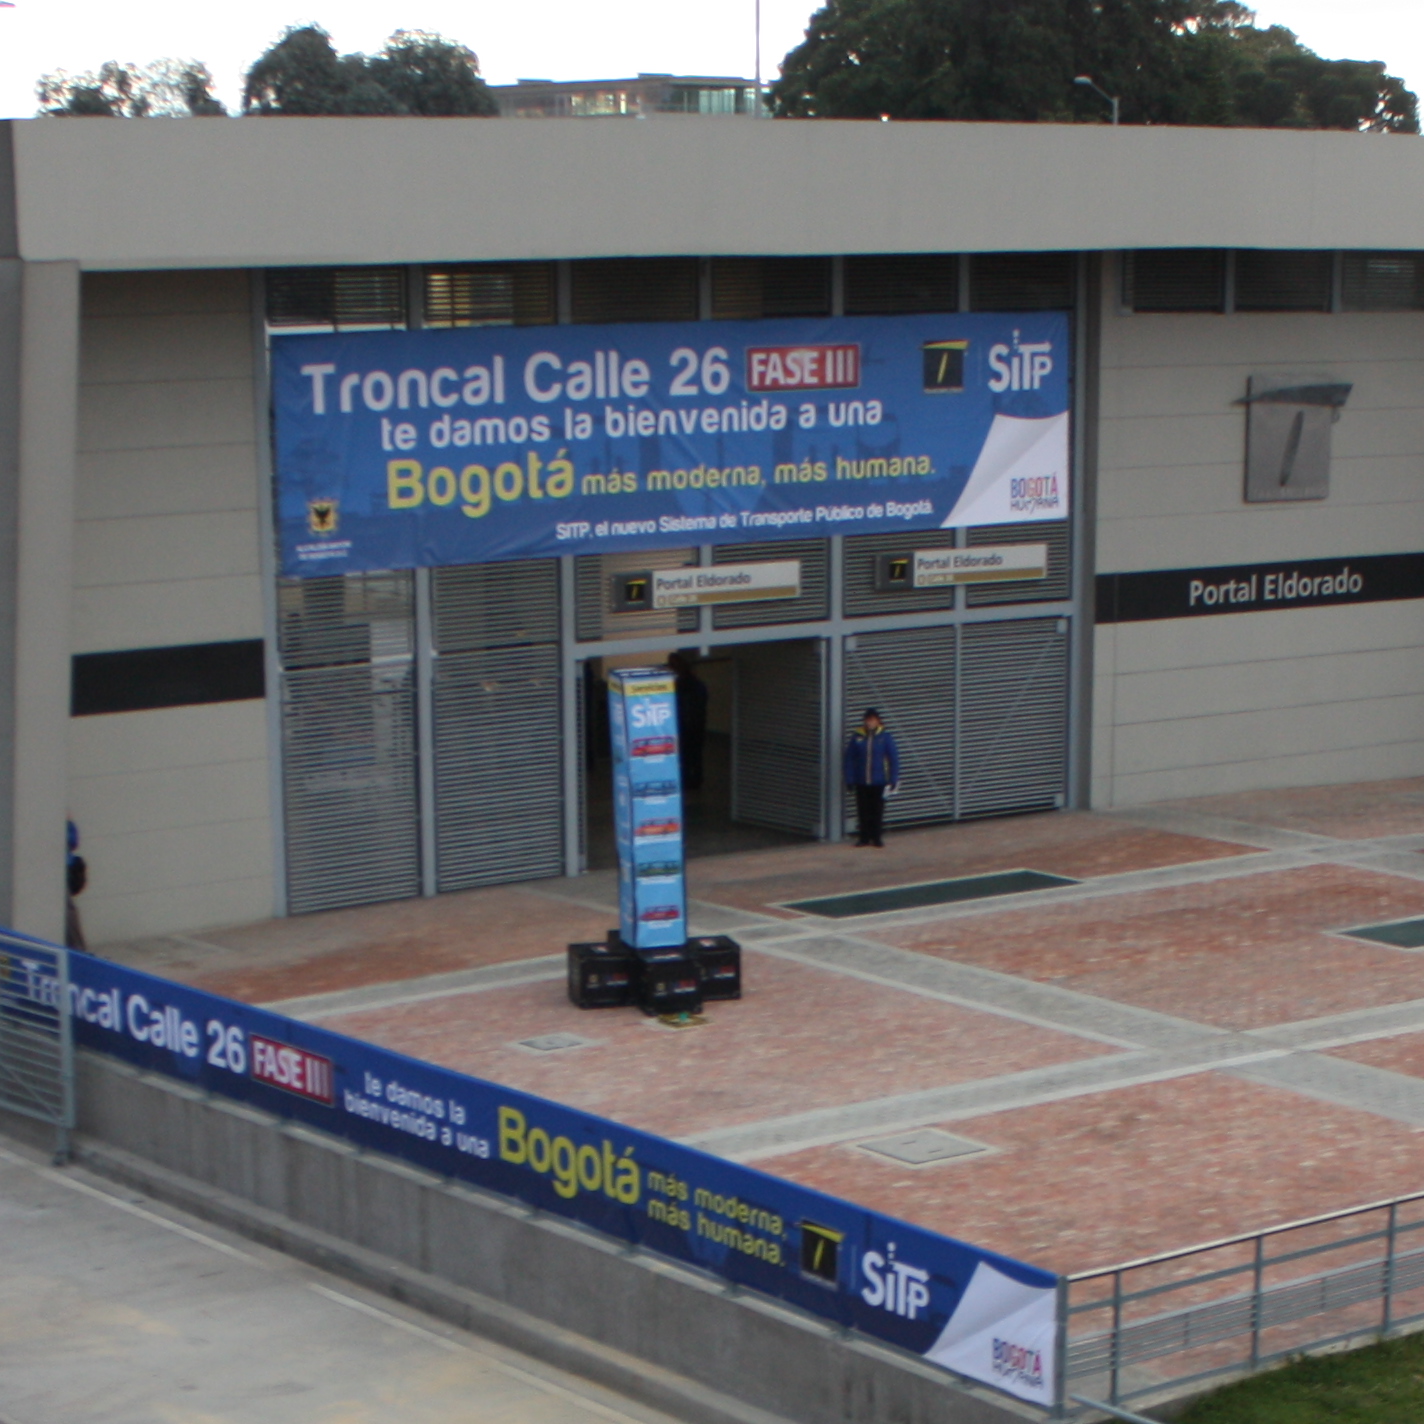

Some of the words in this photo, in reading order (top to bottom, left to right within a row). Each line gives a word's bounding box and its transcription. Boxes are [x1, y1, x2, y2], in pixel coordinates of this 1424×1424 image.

[300, 355, 506, 415] Troncal
[523, 350, 651, 403] Calle
[668, 347, 731, 397] 26
[750, 351, 819, 386] FASE
[380, 417, 417, 452] te
[429, 413, 551, 450] damos
[564, 407, 593, 441] la
[605, 400, 788, 438] bienvenida
[798, 402, 817, 429] a
[828, 399, 883, 426] una
[387, 448, 575, 519] Bogotá
[581, 467, 638, 497] más
[646, 463, 767, 493] moderna,
[774, 456, 828, 484] más
[836, 454, 937, 480] humana.
[611, 518, 657, 537] nuevo
[659, 509, 716, 533] Sistema
[718, 507, 737, 530] de
[739, 504, 813, 529] Transporte
[814, 499, 864, 522] Público
[866, 496, 884, 518] de
[656, 575, 695, 591] Portal
[696, 571, 752, 588] Eldorado
[917, 557, 952, 571] Portal
[953, 552, 1003, 568] Eldorado
[1189, 574, 1258, 607] Portal
[1264, 567, 1364, 600] Eldorado
[126, 994, 200, 1059] Calle
[205, 1019, 247, 1075] 26
[251, 1041, 305, 1090] FASE
[343, 1087, 437, 1142] bienvenida
[440, 1126, 454, 1147] a
[456, 1132, 491, 1160] una
[385, 1080, 446, 1120] damos
[448, 1099, 467, 1127] la
[498, 1106, 641, 1205] Bogotá
[647, 1170, 690, 1201] más
[694, 1187, 790, 1242] moderna,
[647, 1198, 693, 1231] más
[696, 1211, 787, 1268] humana.
